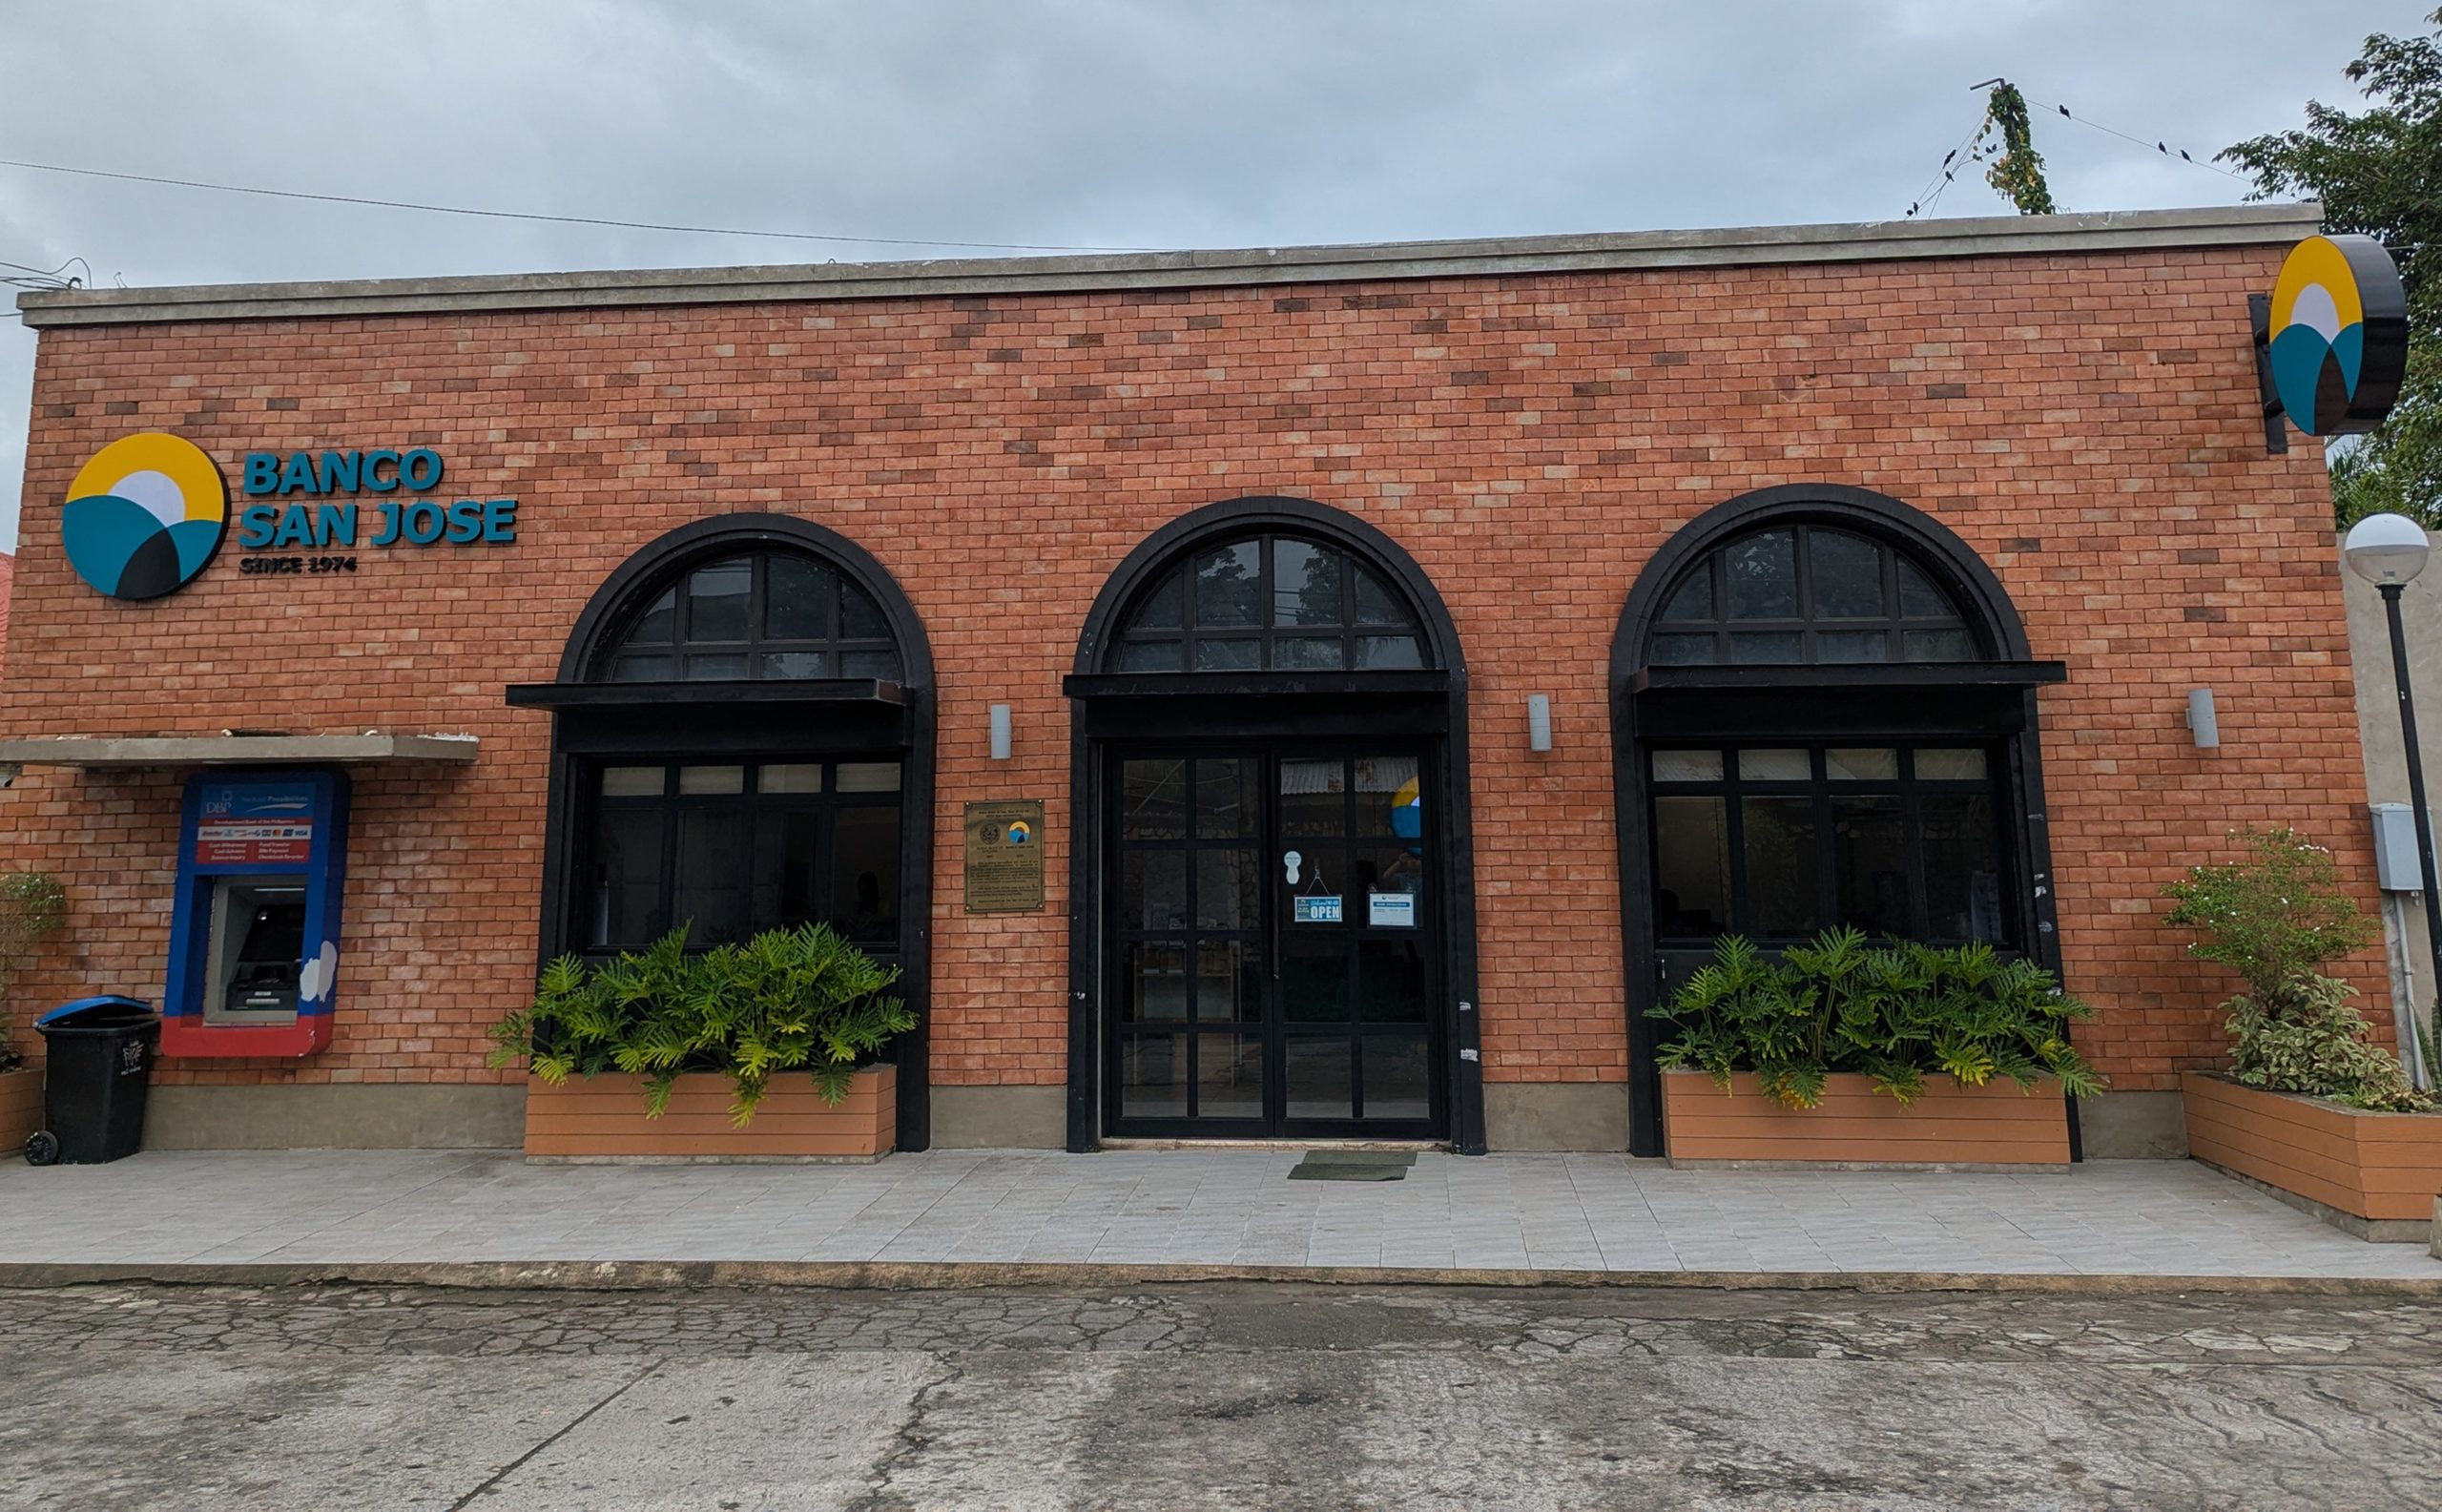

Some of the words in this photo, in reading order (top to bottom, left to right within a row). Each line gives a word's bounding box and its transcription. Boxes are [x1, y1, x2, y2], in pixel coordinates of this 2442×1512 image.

[244, 448, 444, 495] BANCO
[238, 503, 358, 549] SAN
[371, 499, 517, 547] JOSE
[240, 557, 302, 572] SINCE
[308, 556, 358, 571] 1974
[206, 801, 232, 814] DBP
[1310, 906, 1339, 919] OPEN
